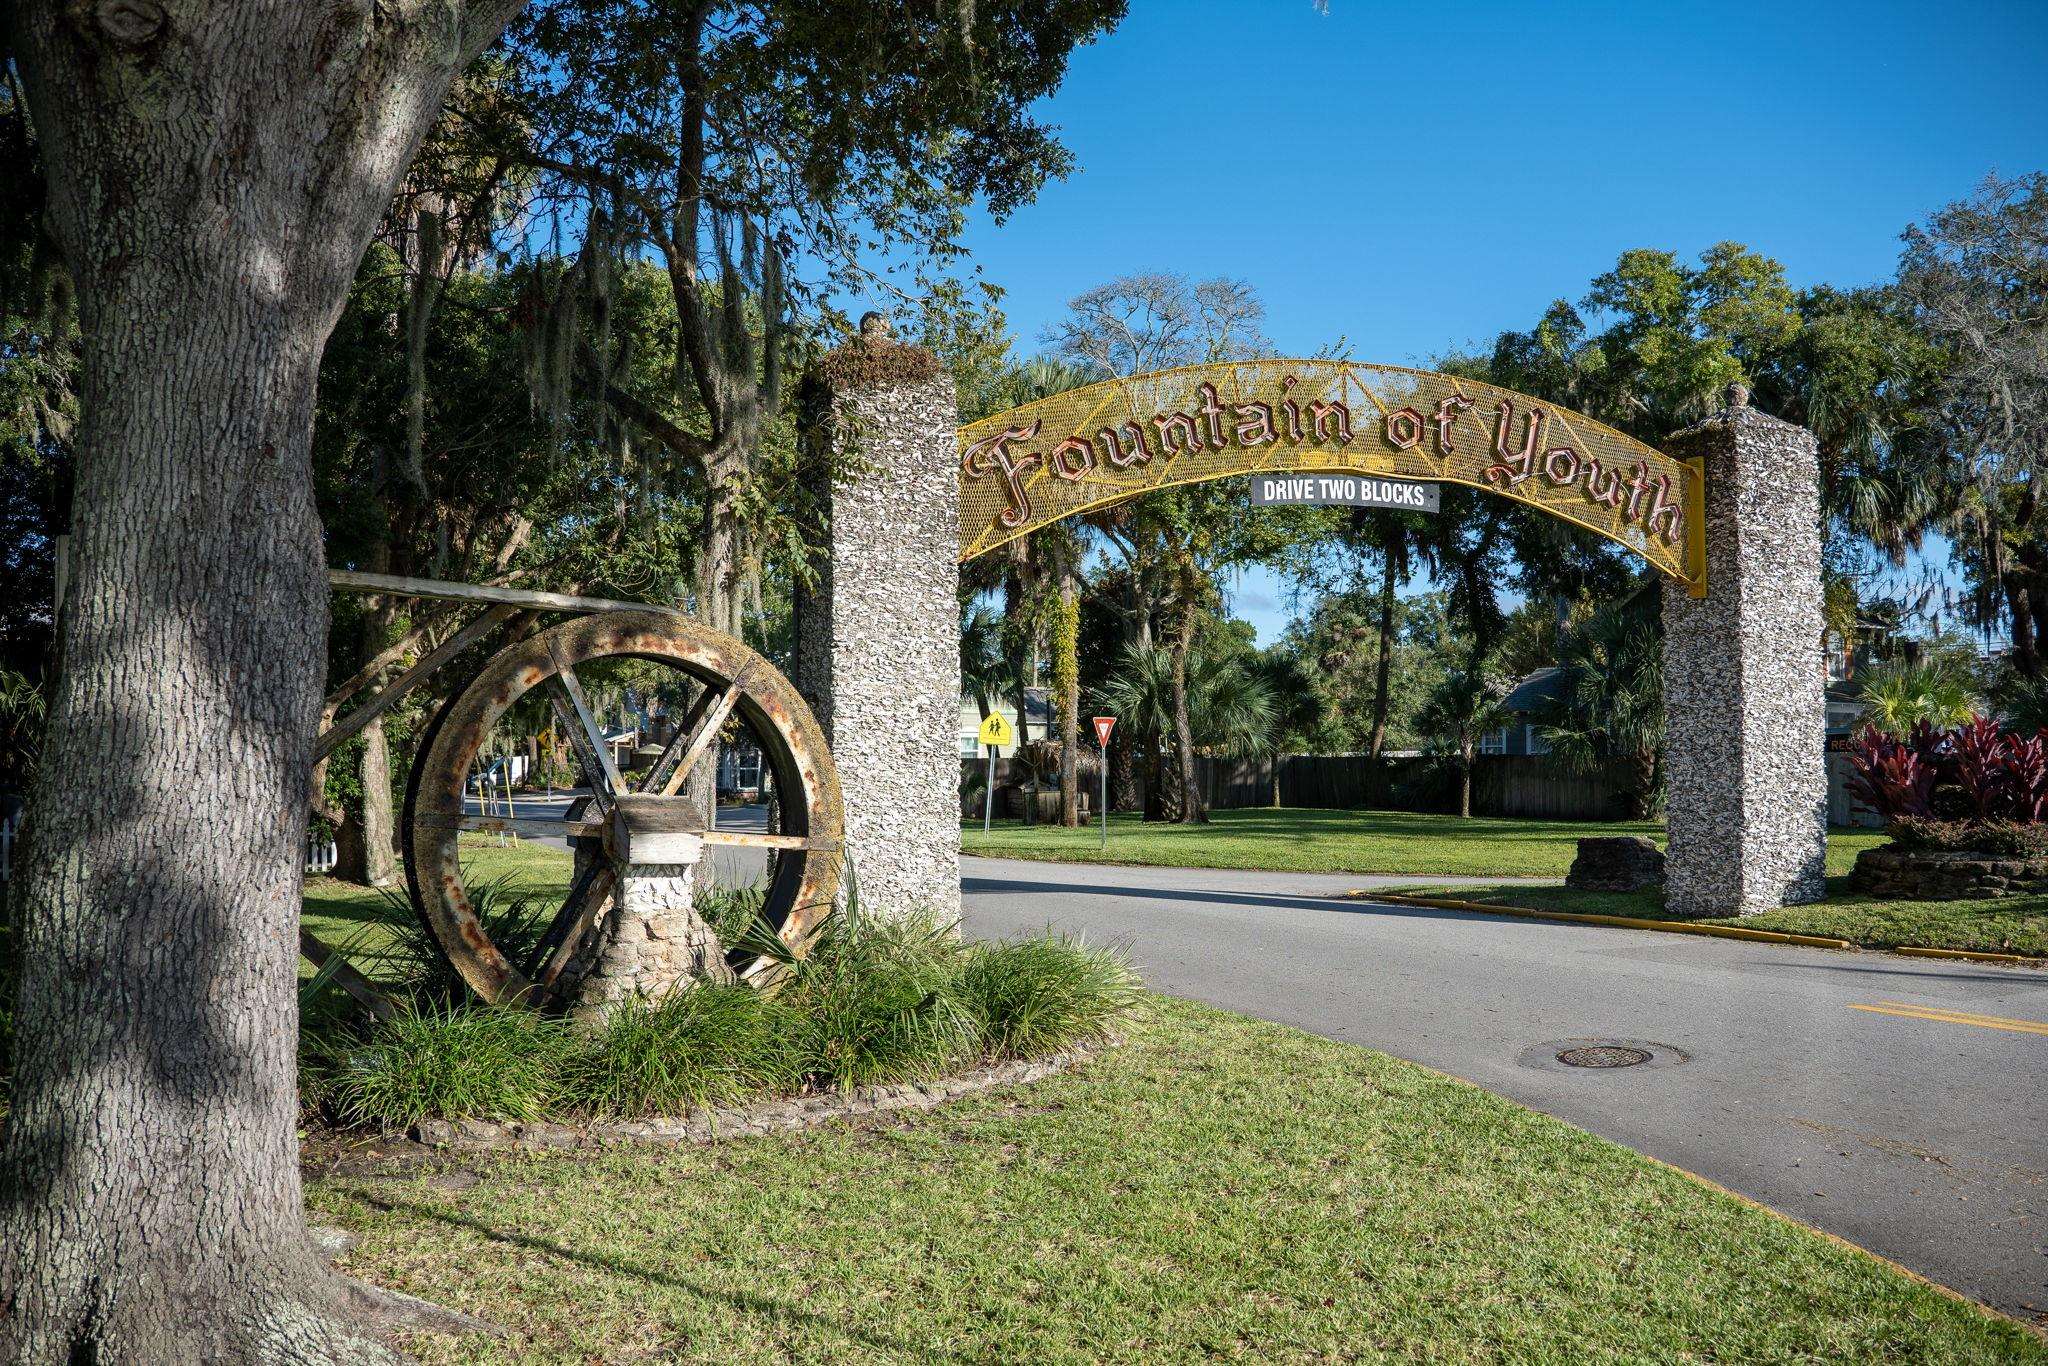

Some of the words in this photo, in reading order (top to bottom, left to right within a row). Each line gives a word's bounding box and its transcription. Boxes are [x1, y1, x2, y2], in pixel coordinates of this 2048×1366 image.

[962, 375, 1355, 527] Fountain
[1387, 393, 1476, 455] of
[1484, 398, 1683, 543] Youth
[1263, 479, 1315, 501] DRIVE
[1318, 479, 1356, 500] TWO
[1361, 481, 1425, 506] BLOCKS
